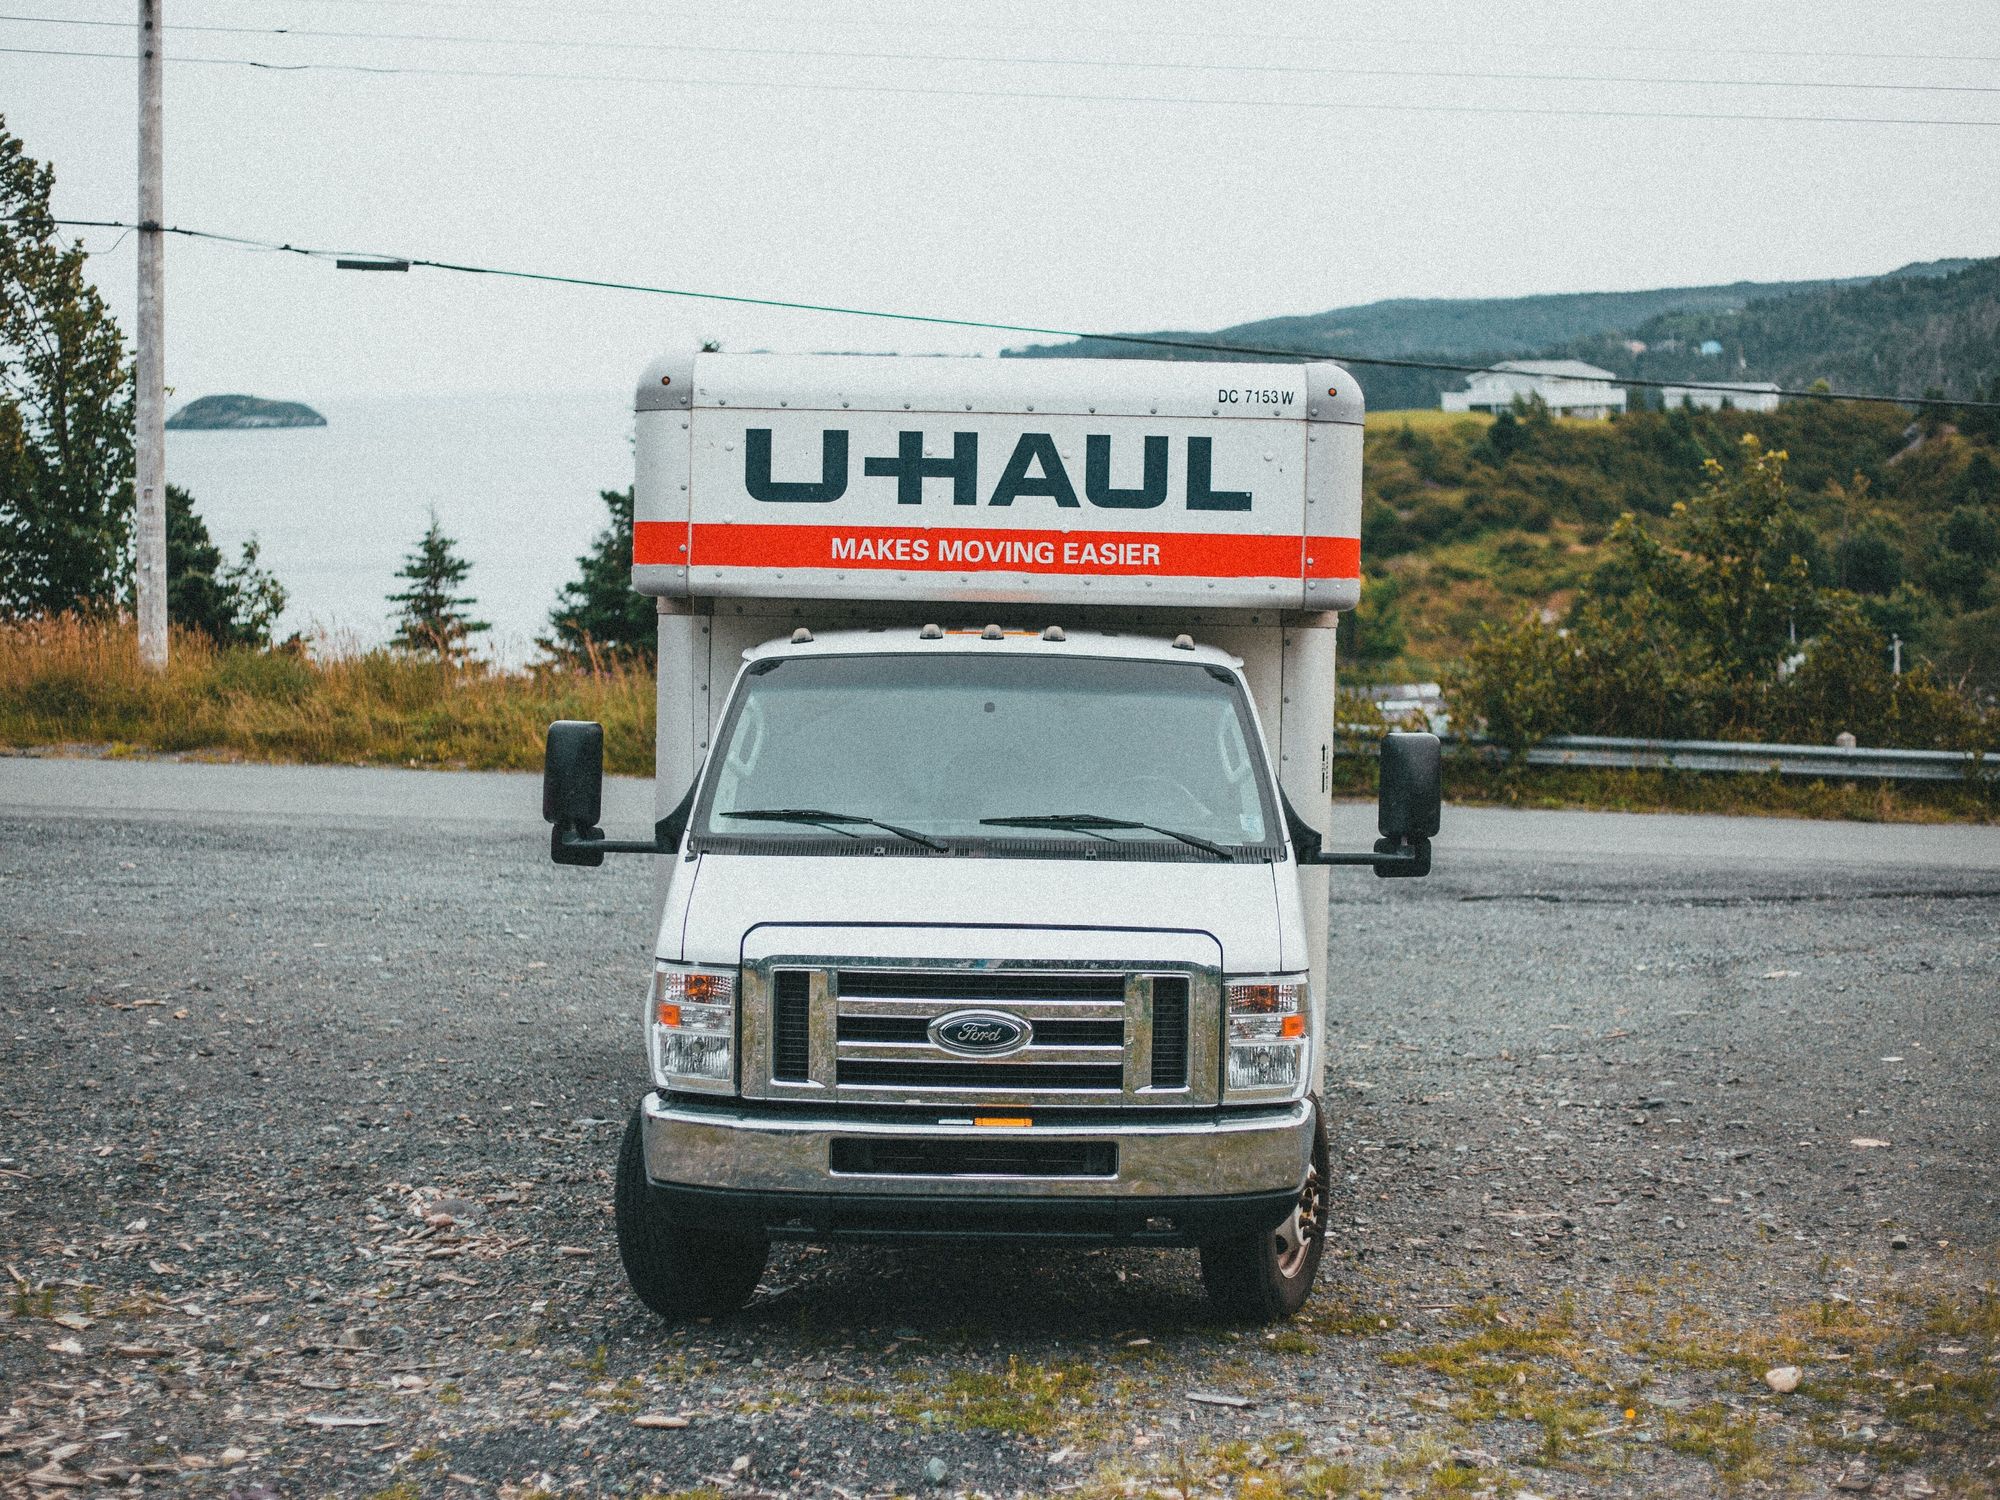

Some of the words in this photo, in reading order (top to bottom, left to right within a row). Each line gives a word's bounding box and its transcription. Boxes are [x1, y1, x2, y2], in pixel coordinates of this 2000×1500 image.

[1218, 389, 1239, 403] DC
[745, 428, 1253, 511] U-HAUL
[831, 536, 930, 563] MAKES
[938, 541, 1055, 565] MOVING
[1063, 543, 1161, 567] EASIER
[957, 1022, 1002, 1041] Ford
